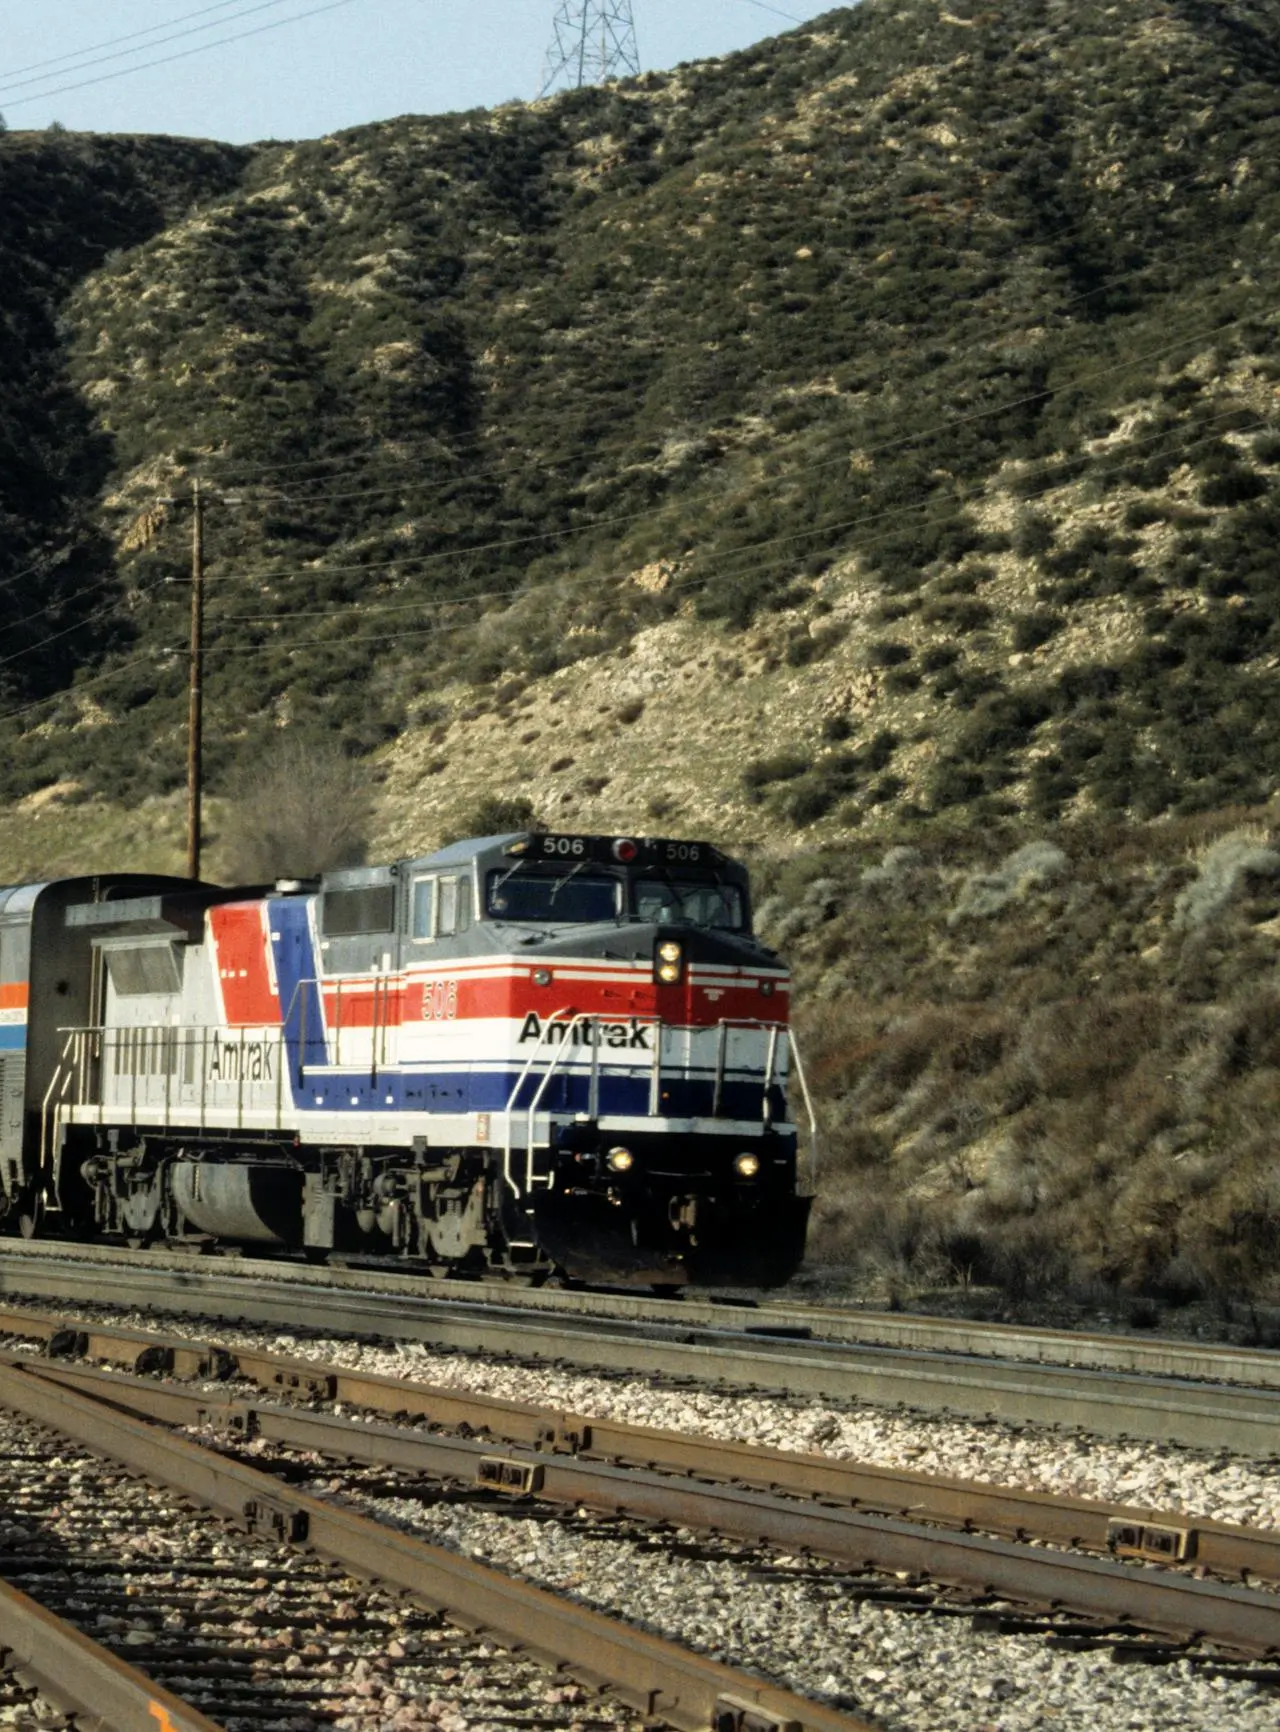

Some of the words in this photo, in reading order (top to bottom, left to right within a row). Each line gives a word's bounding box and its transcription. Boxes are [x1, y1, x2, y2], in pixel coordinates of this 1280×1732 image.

[543, 837, 584, 854] 506
[666, 844, 700, 861] 506
[422, 980, 457, 1020] 506
[518, 1012, 650, 1049] Amtrak
[209, 1028, 273, 1081] Amtrak
